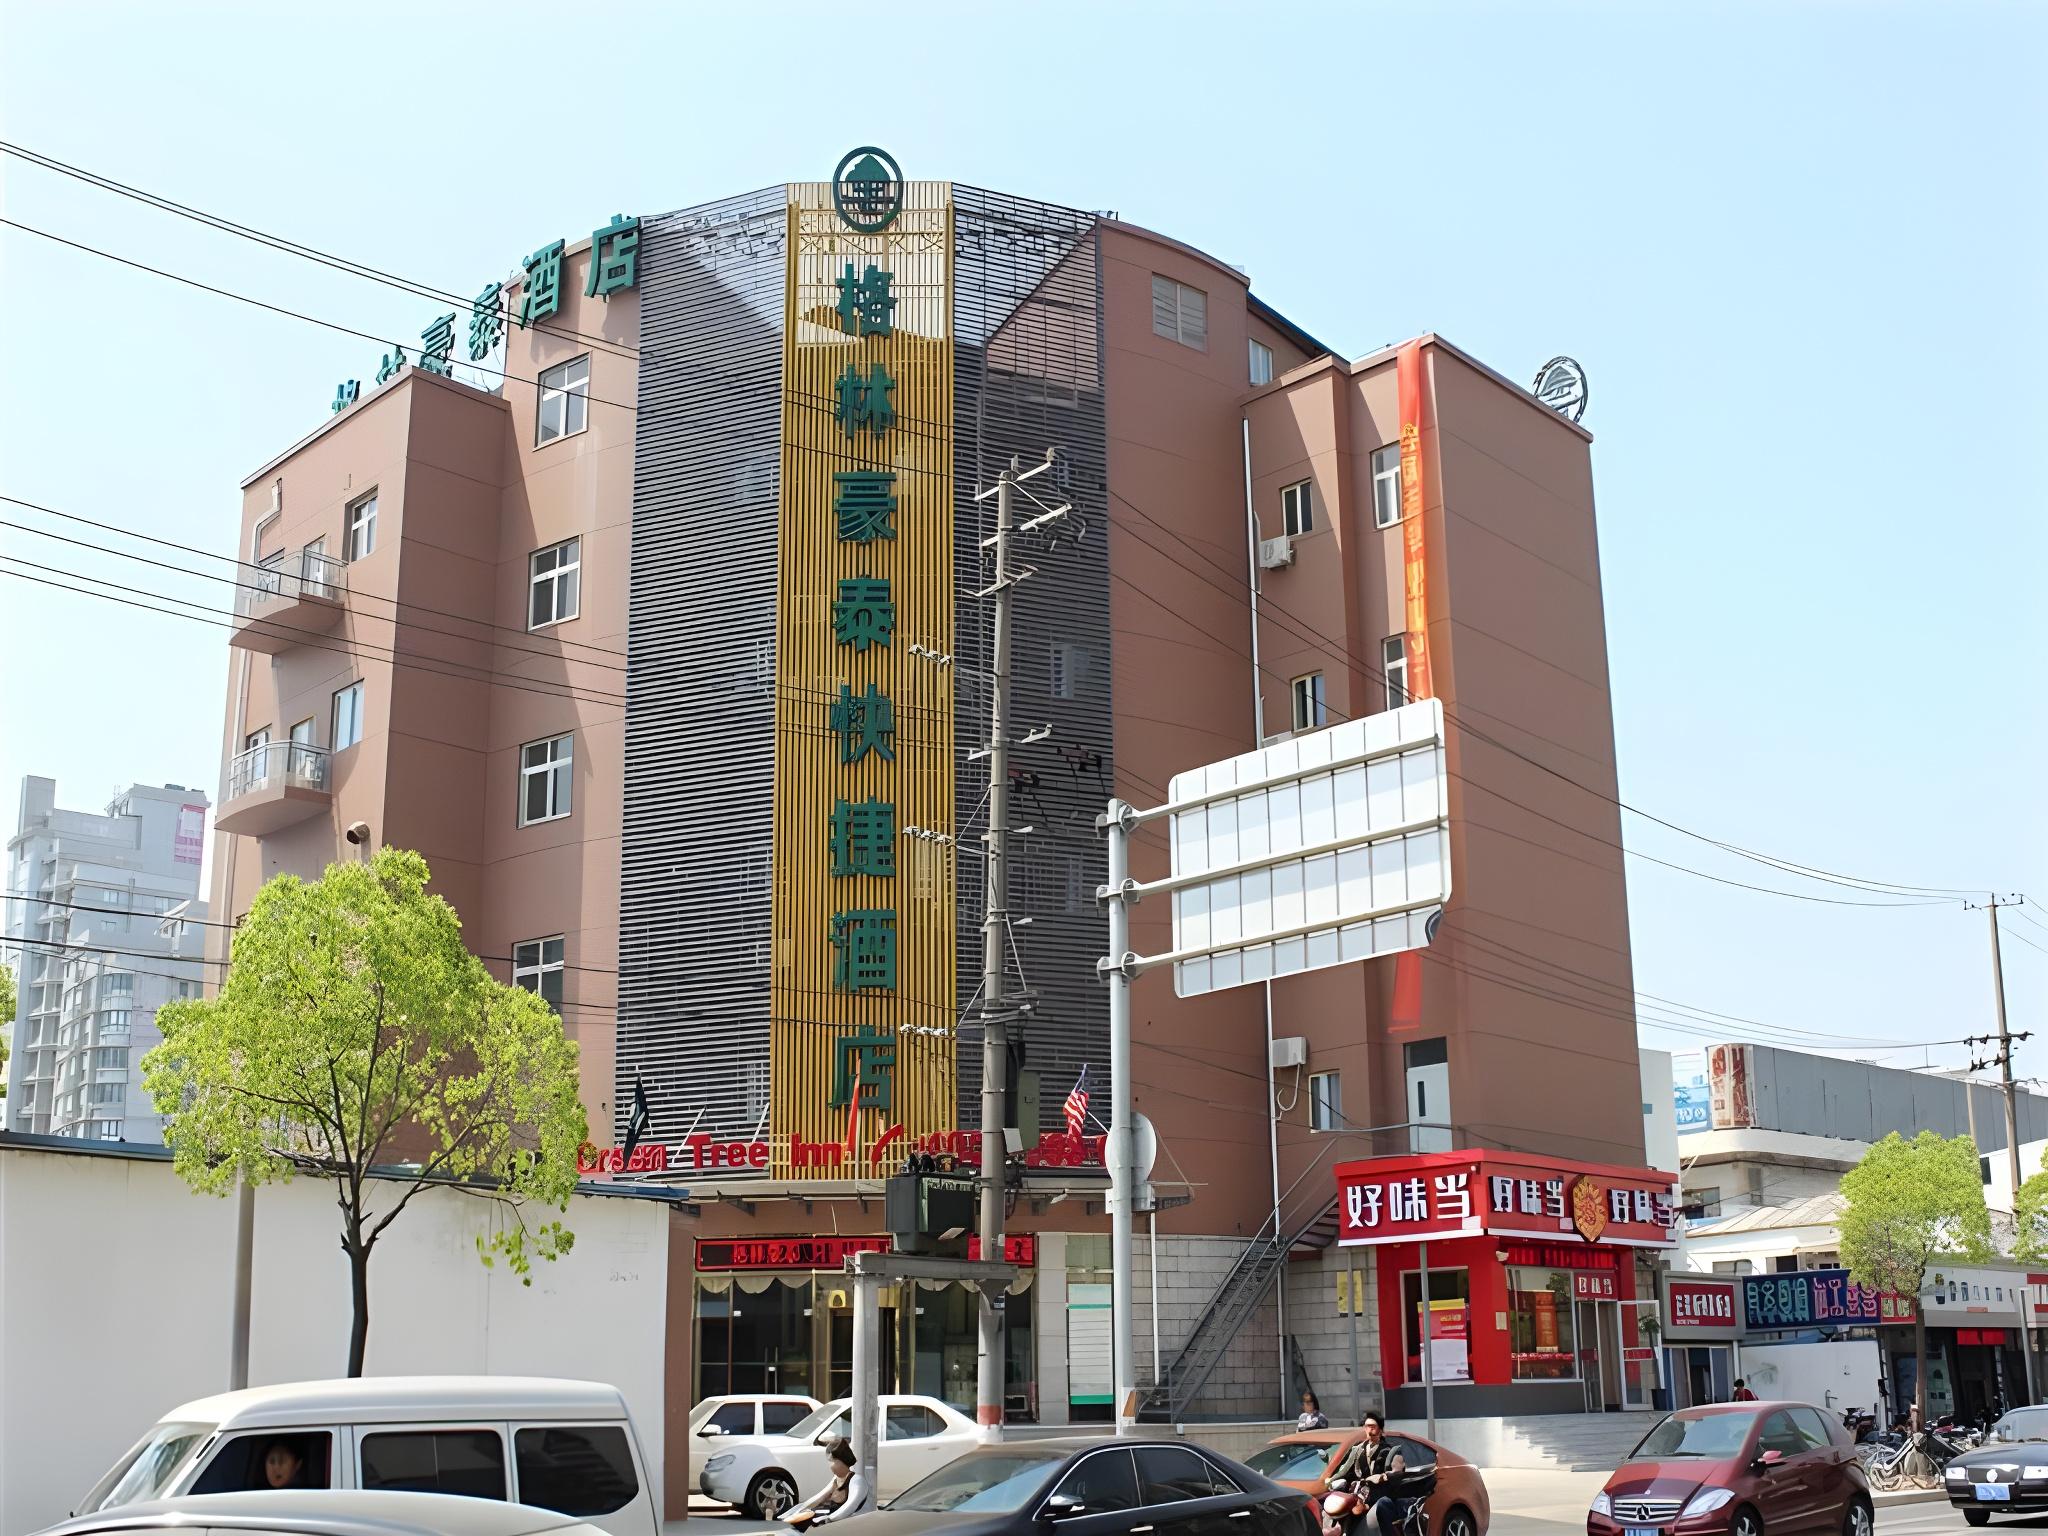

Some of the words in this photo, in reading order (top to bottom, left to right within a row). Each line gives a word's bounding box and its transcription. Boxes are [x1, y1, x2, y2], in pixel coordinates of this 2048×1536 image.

[684, 1132, 770, 1169] Tree
[790, 1132, 842, 1168] Inn
[1346, 1173, 1472, 1228] 好味当
